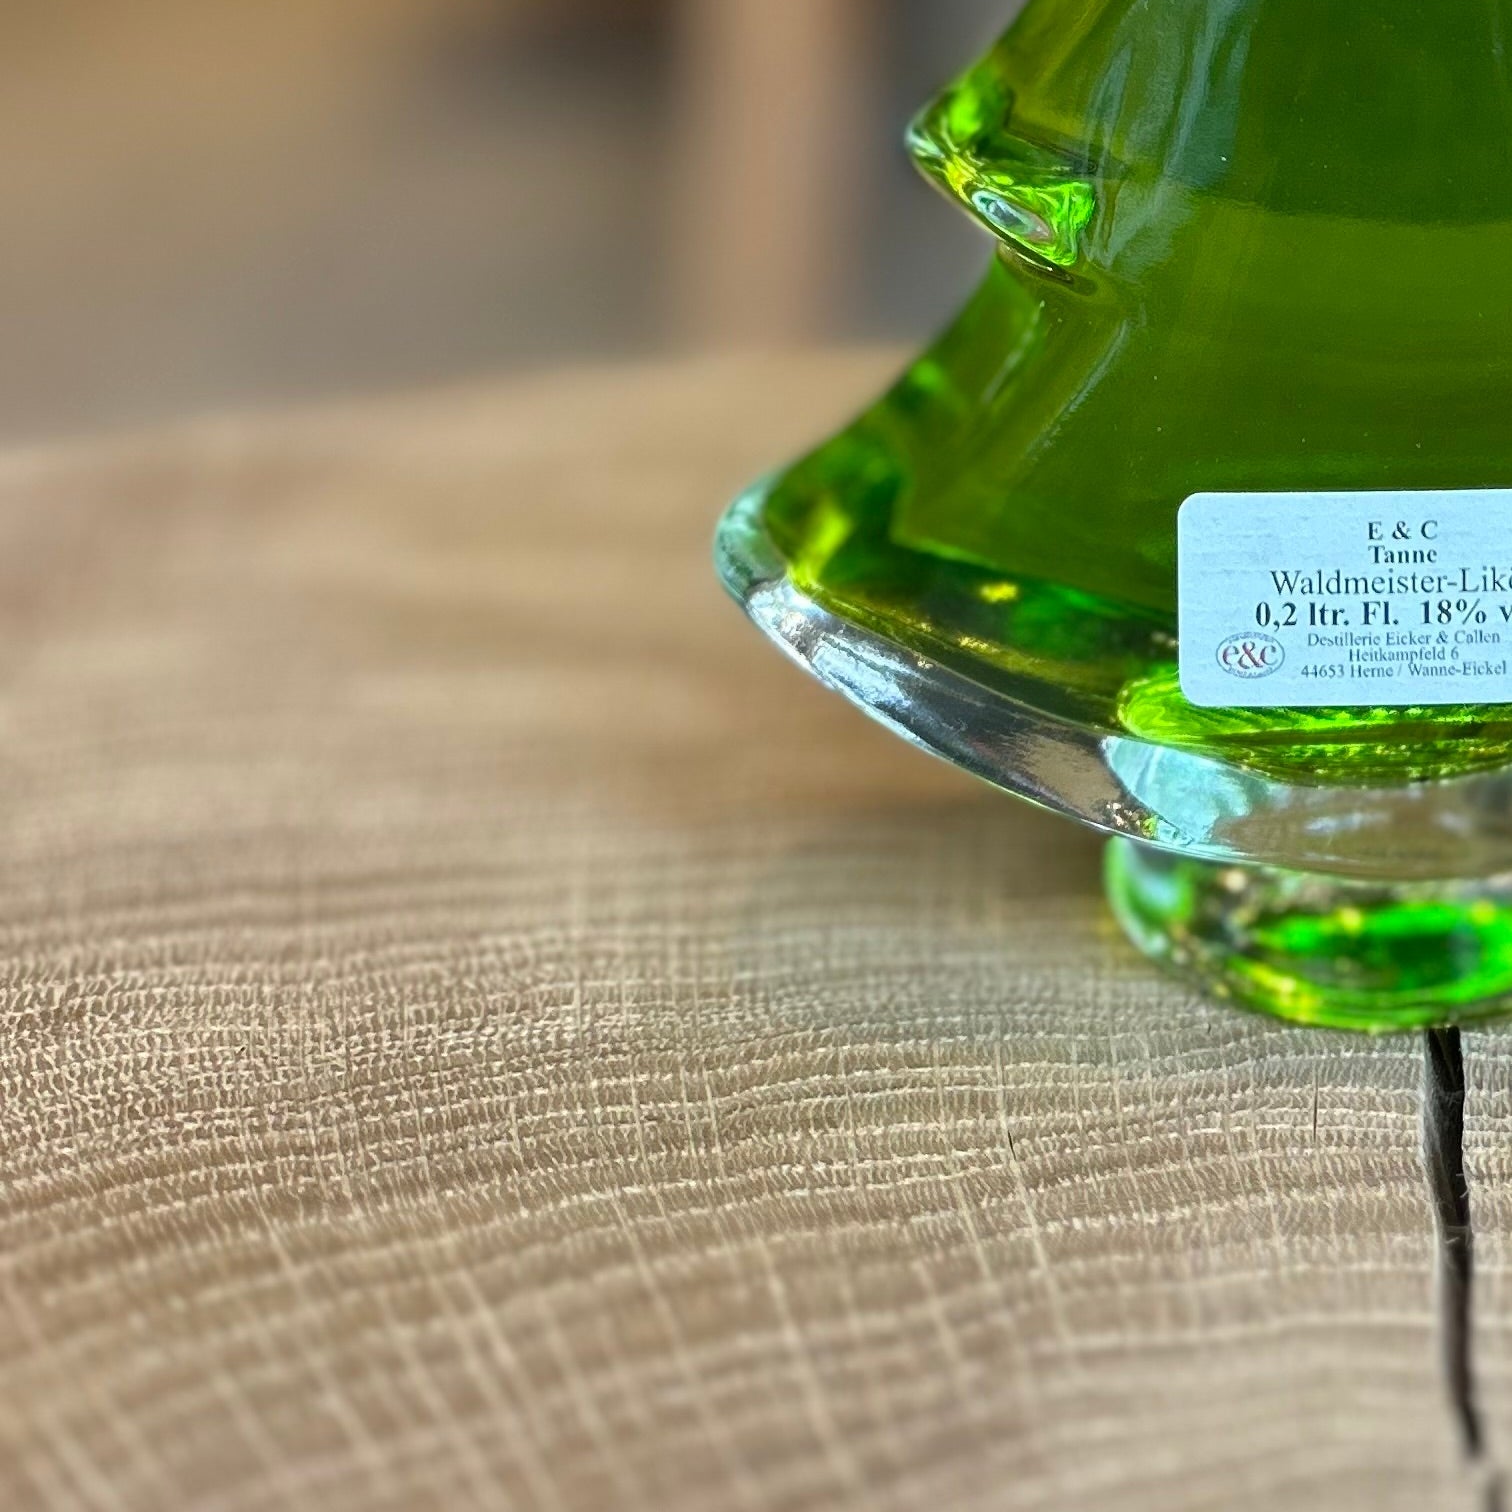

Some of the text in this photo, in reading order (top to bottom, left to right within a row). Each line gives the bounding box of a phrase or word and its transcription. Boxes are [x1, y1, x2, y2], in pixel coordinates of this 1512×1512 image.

[1367, 519, 1439, 541] E & C
[1367, 544, 1438, 565] Tanne
[1255, 600, 1298, 632] 0,2
[1308, 600, 1350, 626] ltr.
[1360, 600, 1399, 626] Fl.
[1420, 597, 1487, 625] 18%
[1307, 629, 1501, 647] Destillerie Eicker & Callen
[1349, 646, 1460, 665] Heitkampfeld 6
[1300, 663, 1345, 679] 44653
[1349, 664, 1394, 678] Herne
[1408, 660, 1508, 677] Wanne-Eickel
